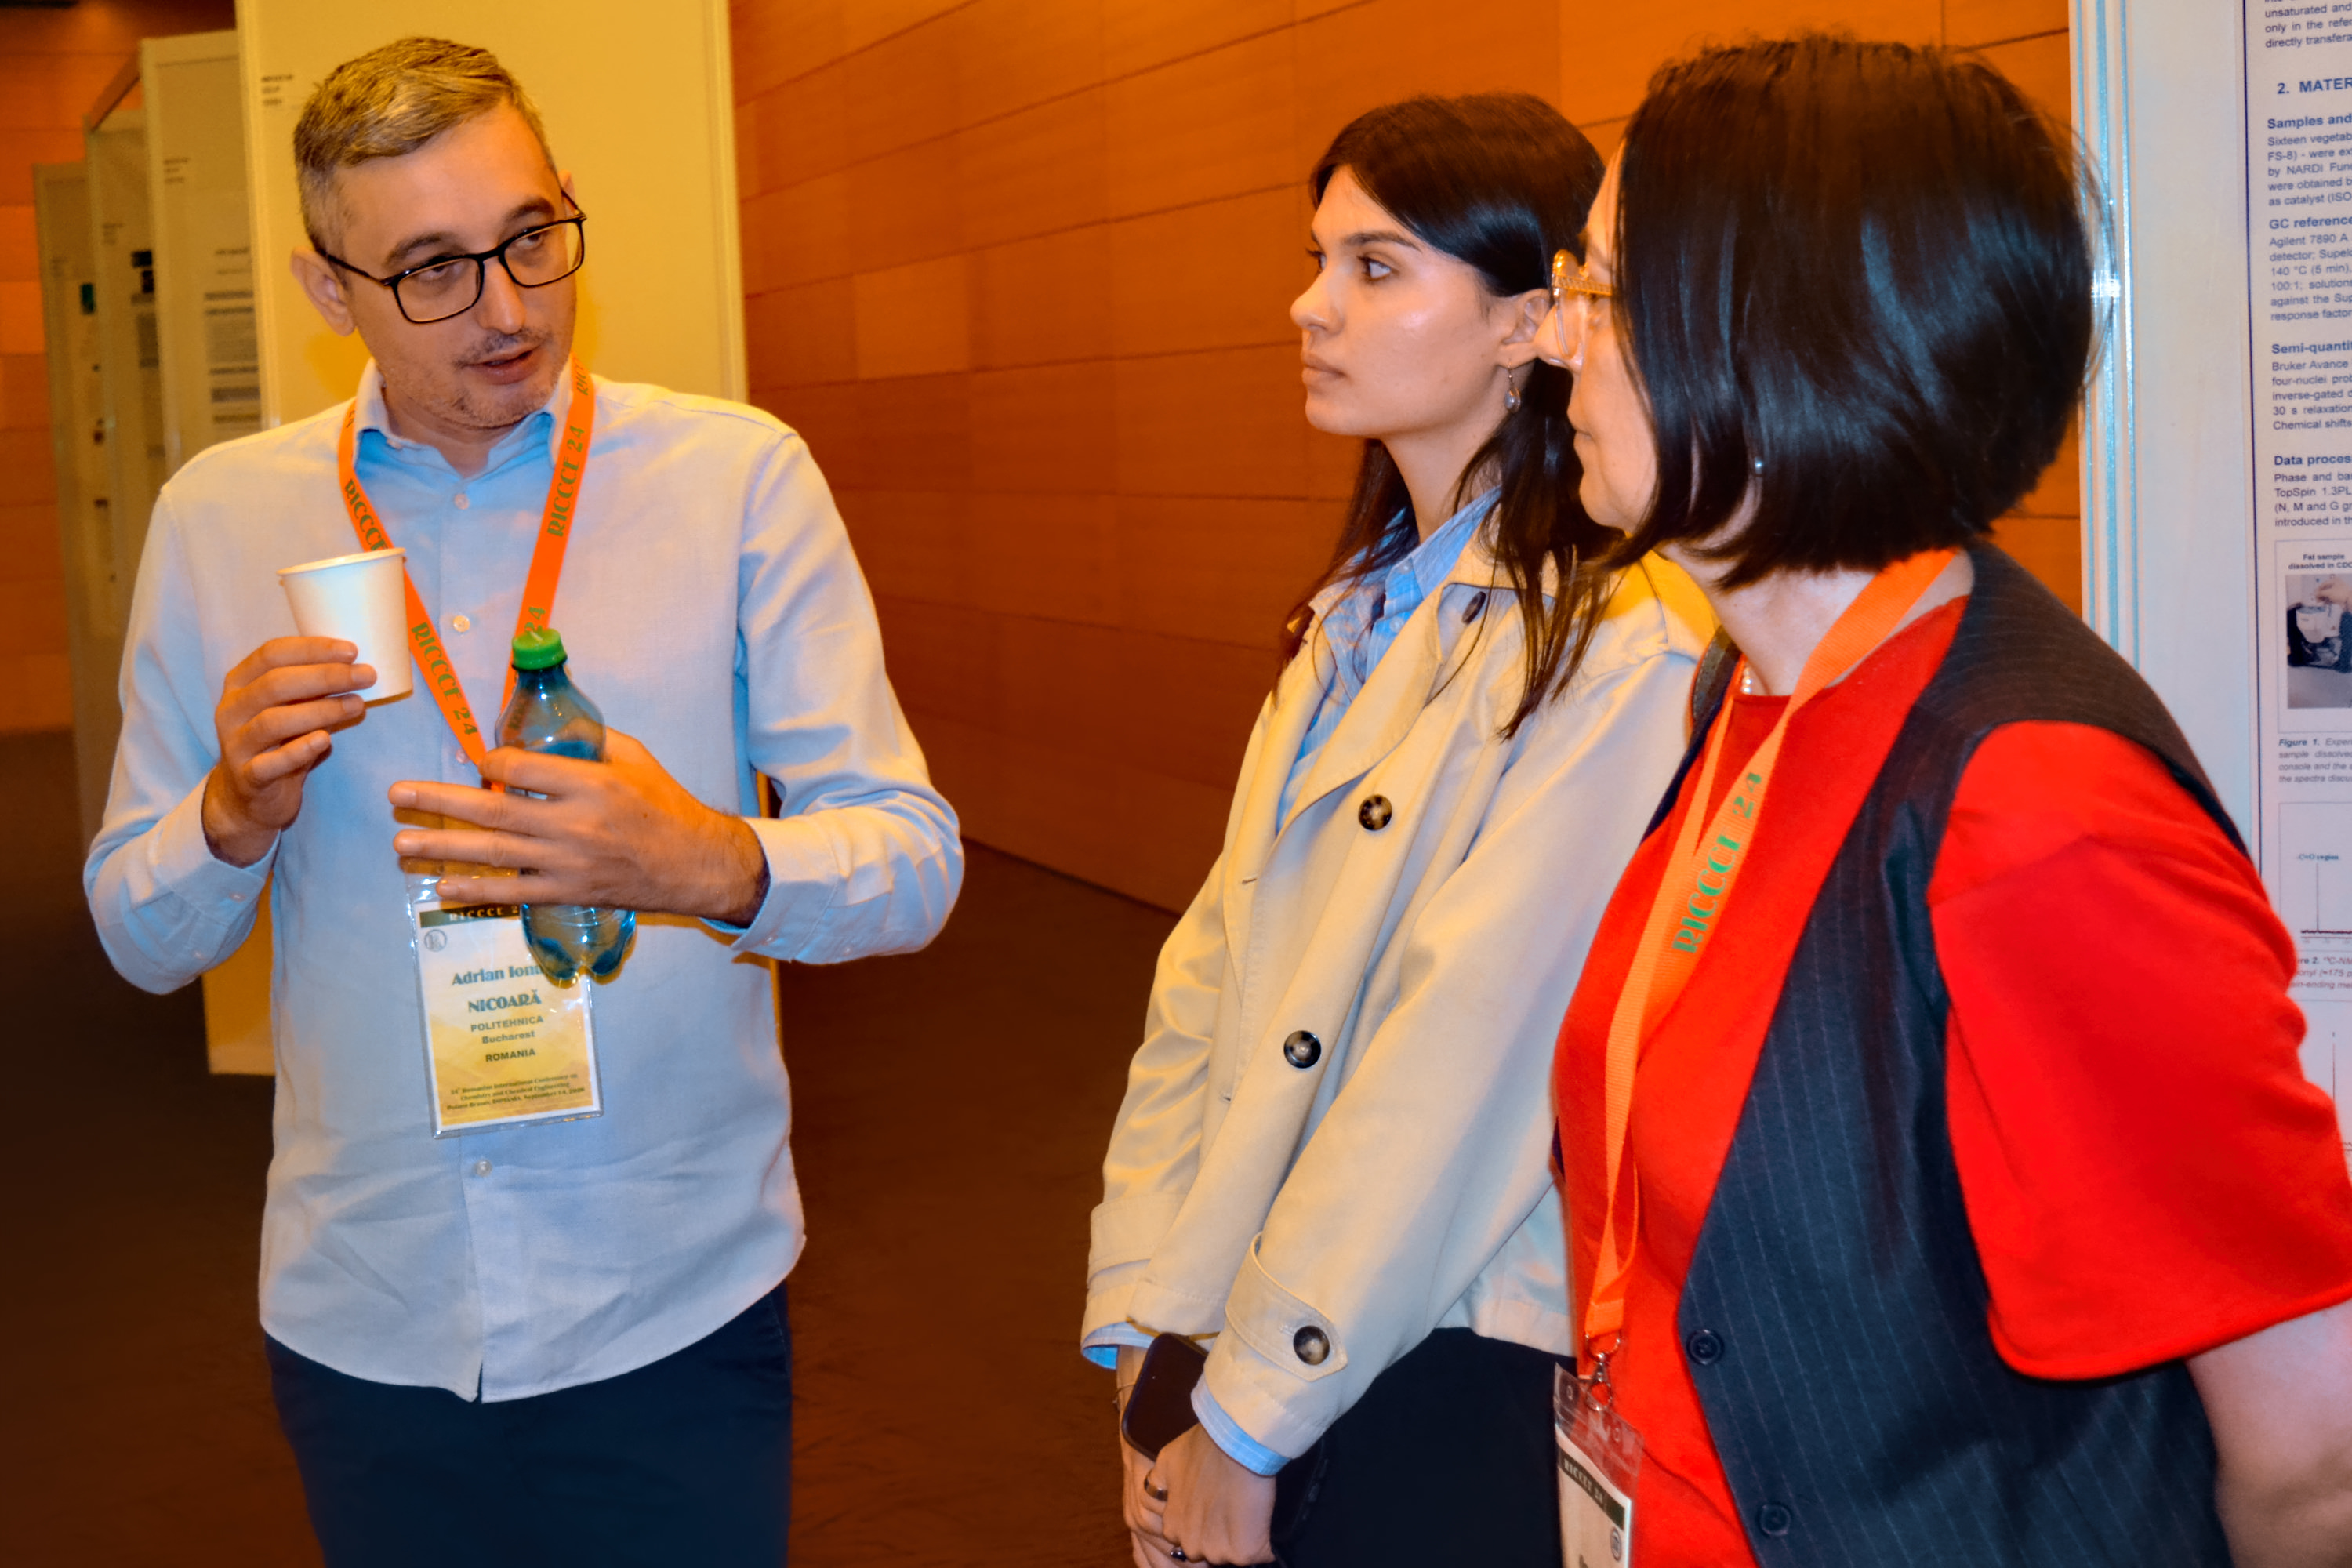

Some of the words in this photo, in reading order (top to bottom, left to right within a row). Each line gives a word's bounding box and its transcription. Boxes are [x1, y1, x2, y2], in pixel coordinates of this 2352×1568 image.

[2265, 5, 2327, 18] unsaturated
[2332, 2, 2352, 13] and
[2265, 23, 2286, 34] only
[2292, 22, 2301, 31] in
[2307, 20, 2323, 29] the
[2265, 37, 2302, 48] directly
[2277, 82, 2290, 94] 2.
[2267, 116, 2323, 129] Samples
[2328, 113, 2352, 125] and
[2267, 136, 2307, 146] Sixteen
[2309, 149, 2335, 158] were
[2268, 166, 2281, 178] by
[2286, 163, 2323, 175] NARDI
[2267, 182, 2294, 191] were
[2297, 177, 2343, 189] obtained
[2269, 198, 2281, 206] as
[2284, 194, 2325, 205] catalyst
[2327, 191, 2352, 204] (ISO
[2269, 218, 2289, 230] GC
[2269, 236, 2306, 249] Agilent
[2310, 234, 2336, 244] 7890
[2339, 233, 2349, 242] A
[2271, 267, 2289, 276] 140
[2310, 264, 2321, 276] (5
[2270, 296, 2309, 308] against
[2313, 295, 2329, 304] the
[2270, 310, 2319, 321] response
[2272, 361, 2306, 372] Bruker
[2309, 360, 2349, 369] Avance
[2272, 374, 2327, 387] four-nuclei
[2272, 389, 2343, 401] inverse-gated
[2273, 406, 2285, 416] 30
[2273, 420, 2321, 430] Chemical
[2325, 419, 2352, 429] shifts
[567, 425, 585, 453] 24
[2274, 455, 2303, 466] Data
[2274, 473, 2307, 482] Phase
[2313, 472, 2332, 481] and
[2274, 488, 2316, 499] TopSpin
[2293, 502, 2303, 511] M
[2307, 502, 2326, 511] and
[2330, 501, 2339, 510] G
[2274, 517, 2328, 527] introduced
[2332, 516, 2341, 525] in
[453, 706, 478, 735] 24
[2278, 739, 2307, 748] Figure
[1732, 772, 1762, 820] 24
[452, 968, 504, 985] Adrian
[467, 989, 542, 1012] NICOARĂ
[470, 1015, 544, 1032] POLITEHNICA
[481, 1030, 535, 1044] Bucharest
[485, 1048, 536, 1062] ROMANIA
